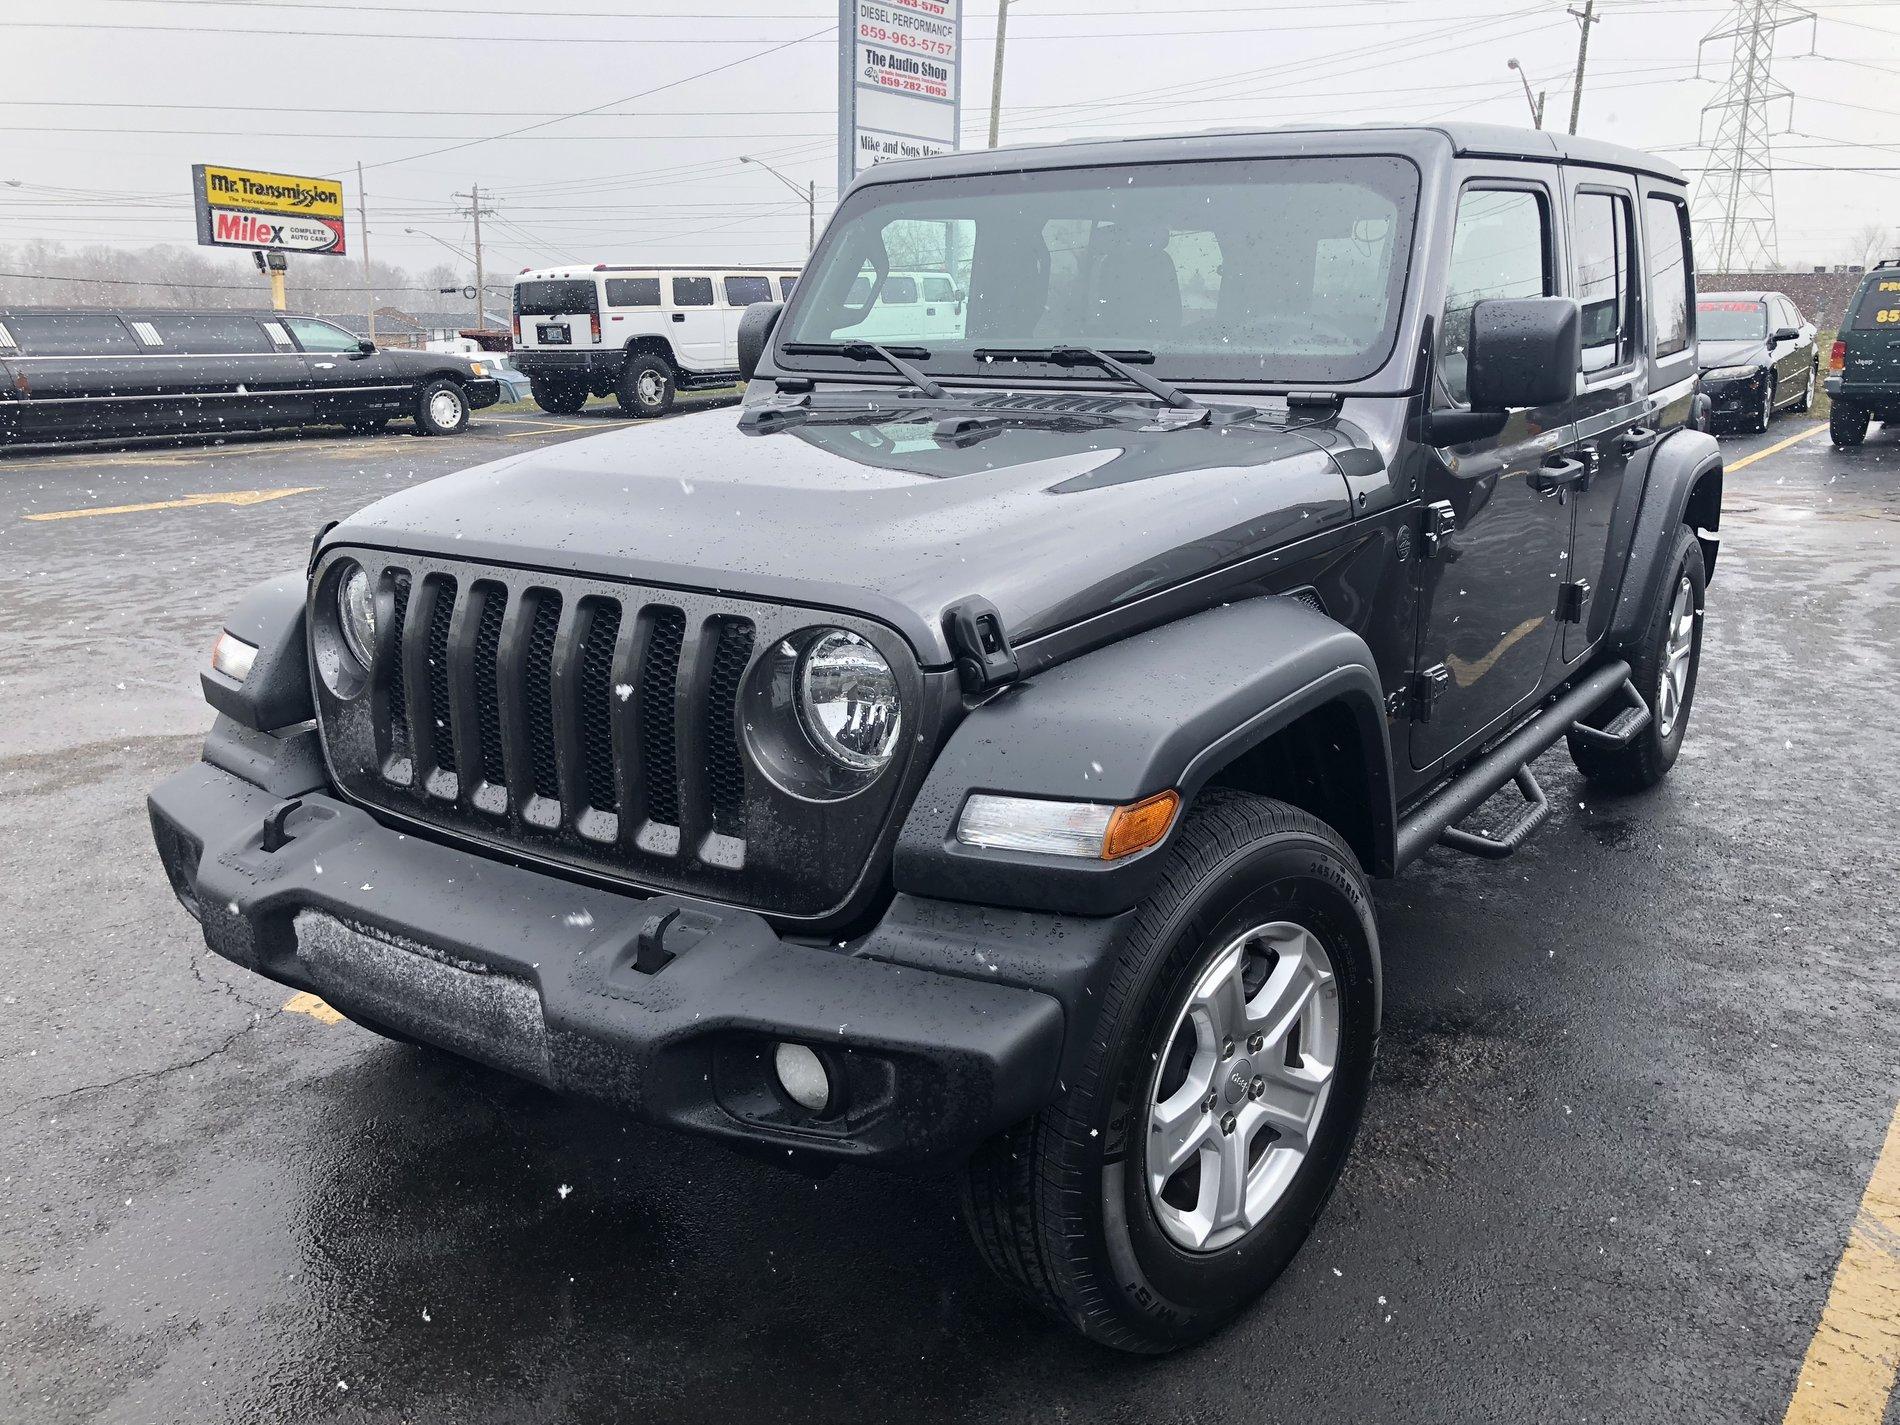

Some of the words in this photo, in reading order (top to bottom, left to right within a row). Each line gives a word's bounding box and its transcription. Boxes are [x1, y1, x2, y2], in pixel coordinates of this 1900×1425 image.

[860, 5, 890, 24] DIESEL
[892, 12, 953, 38] PERFORMANCE
[860, 24, 952, 56] 859-963-5757
[866, 49, 886, 67] The
[889, 54, 919, 75] Audio
[922, 62, 947, 81] Shop
[880, 76, 947, 97] 859-282-1093
[861, 135, 880, 152] Mike
[883, 140, 898, 155] and
[900, 142, 921, 158] Sons
[211, 174, 239, 193] Mr.
[239, 177, 337, 207] Transmission
[217, 213, 285, 244] Milex
[290, 227, 325, 236] COMPLETE
[1876, 310, 1900, 323] 85
